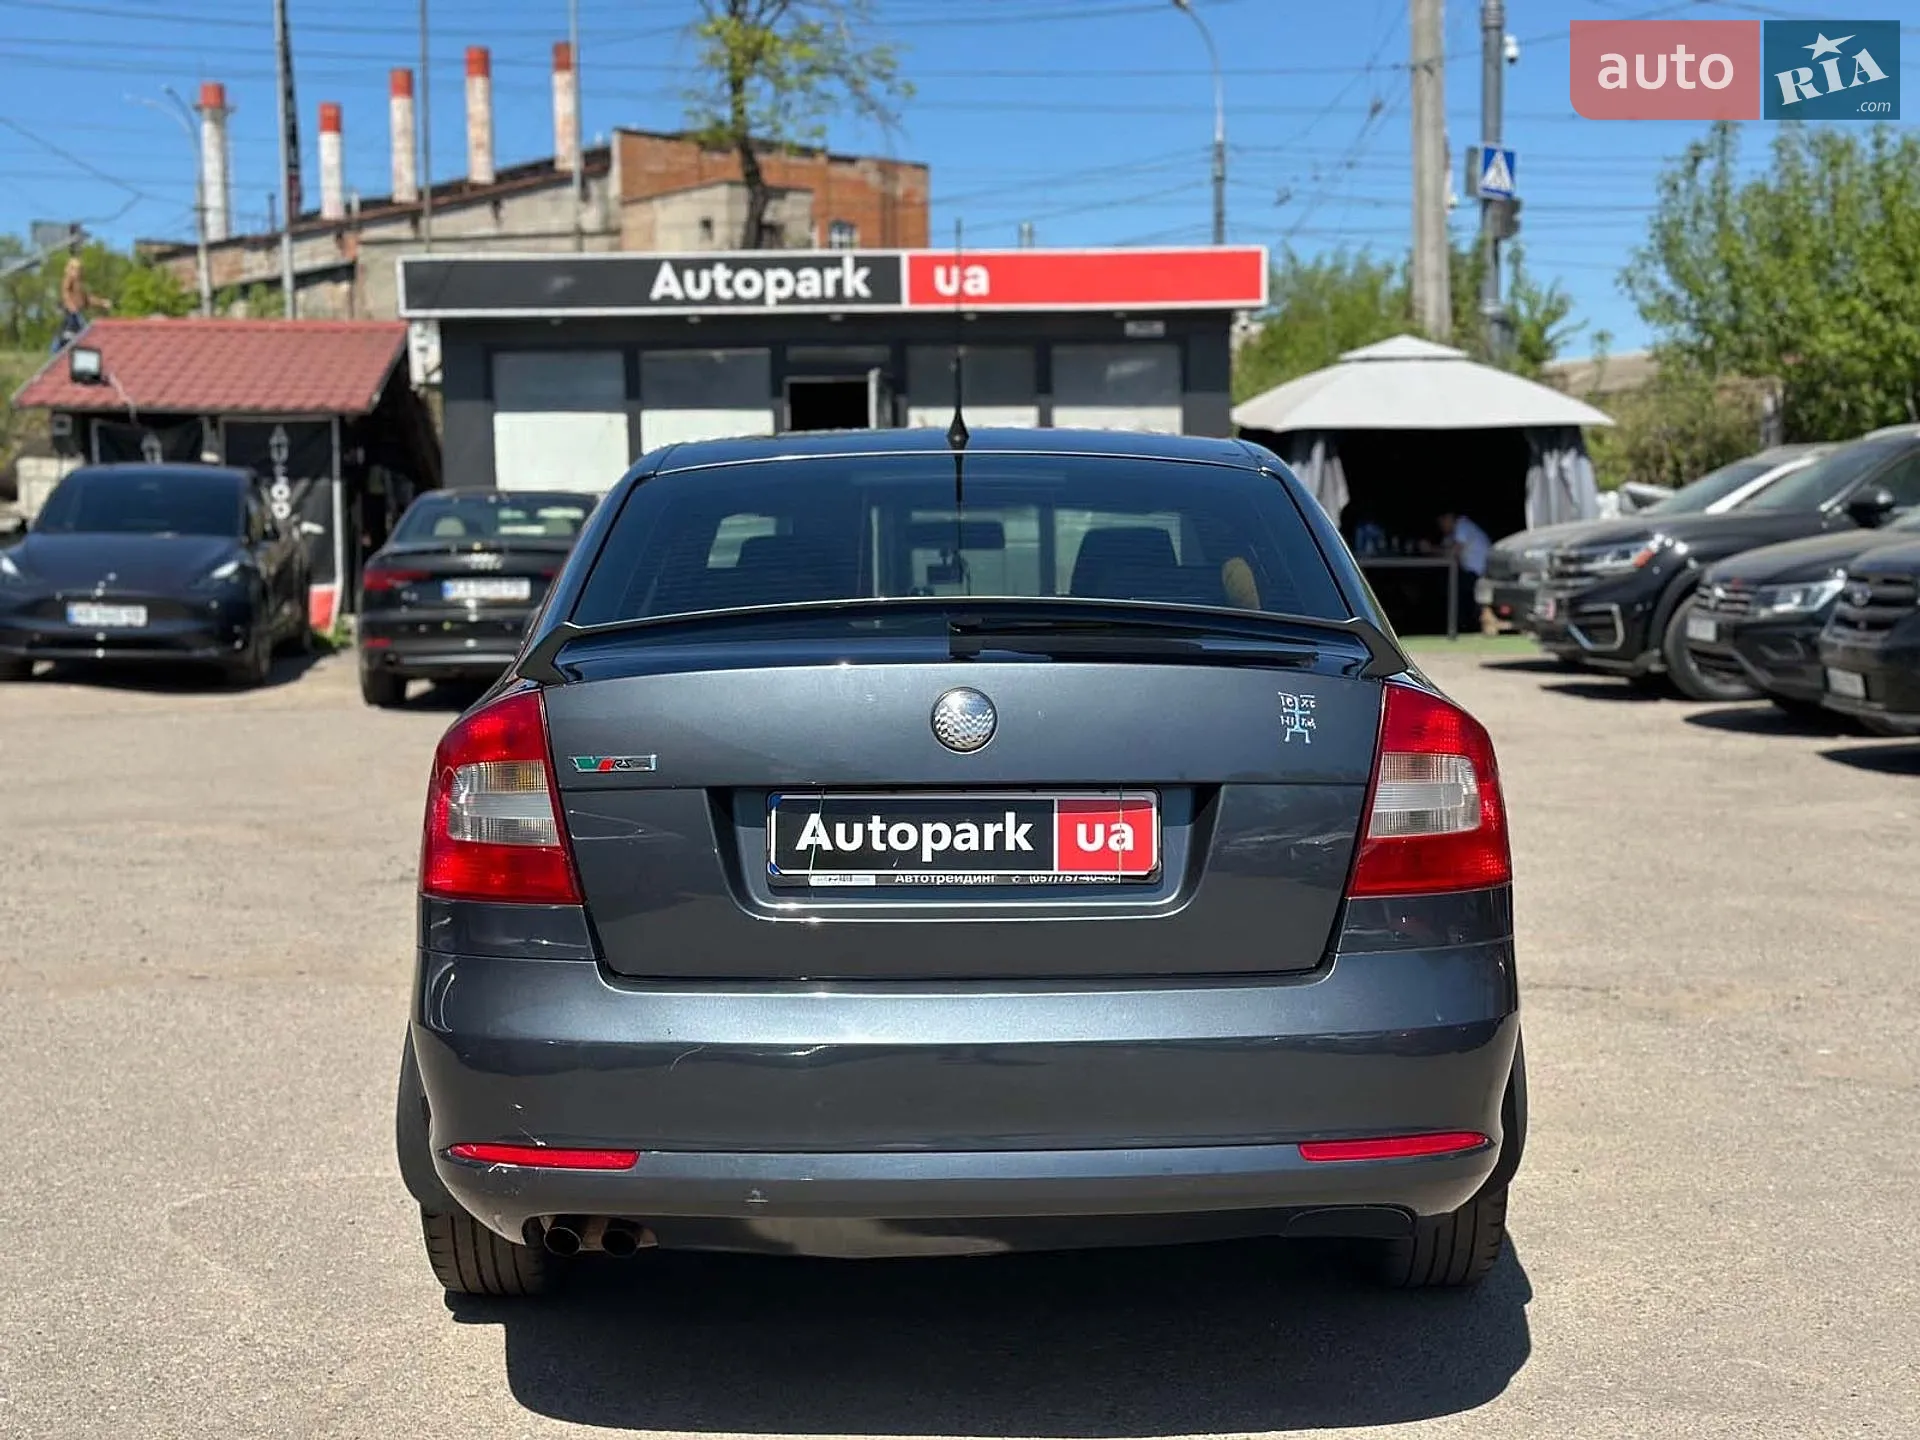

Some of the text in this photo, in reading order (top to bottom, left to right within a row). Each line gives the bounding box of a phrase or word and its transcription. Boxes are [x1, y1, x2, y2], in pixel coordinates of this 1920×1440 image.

[650, 256, 991, 306] Autopark ua
[795, 812, 1134, 862] Autopark ua
